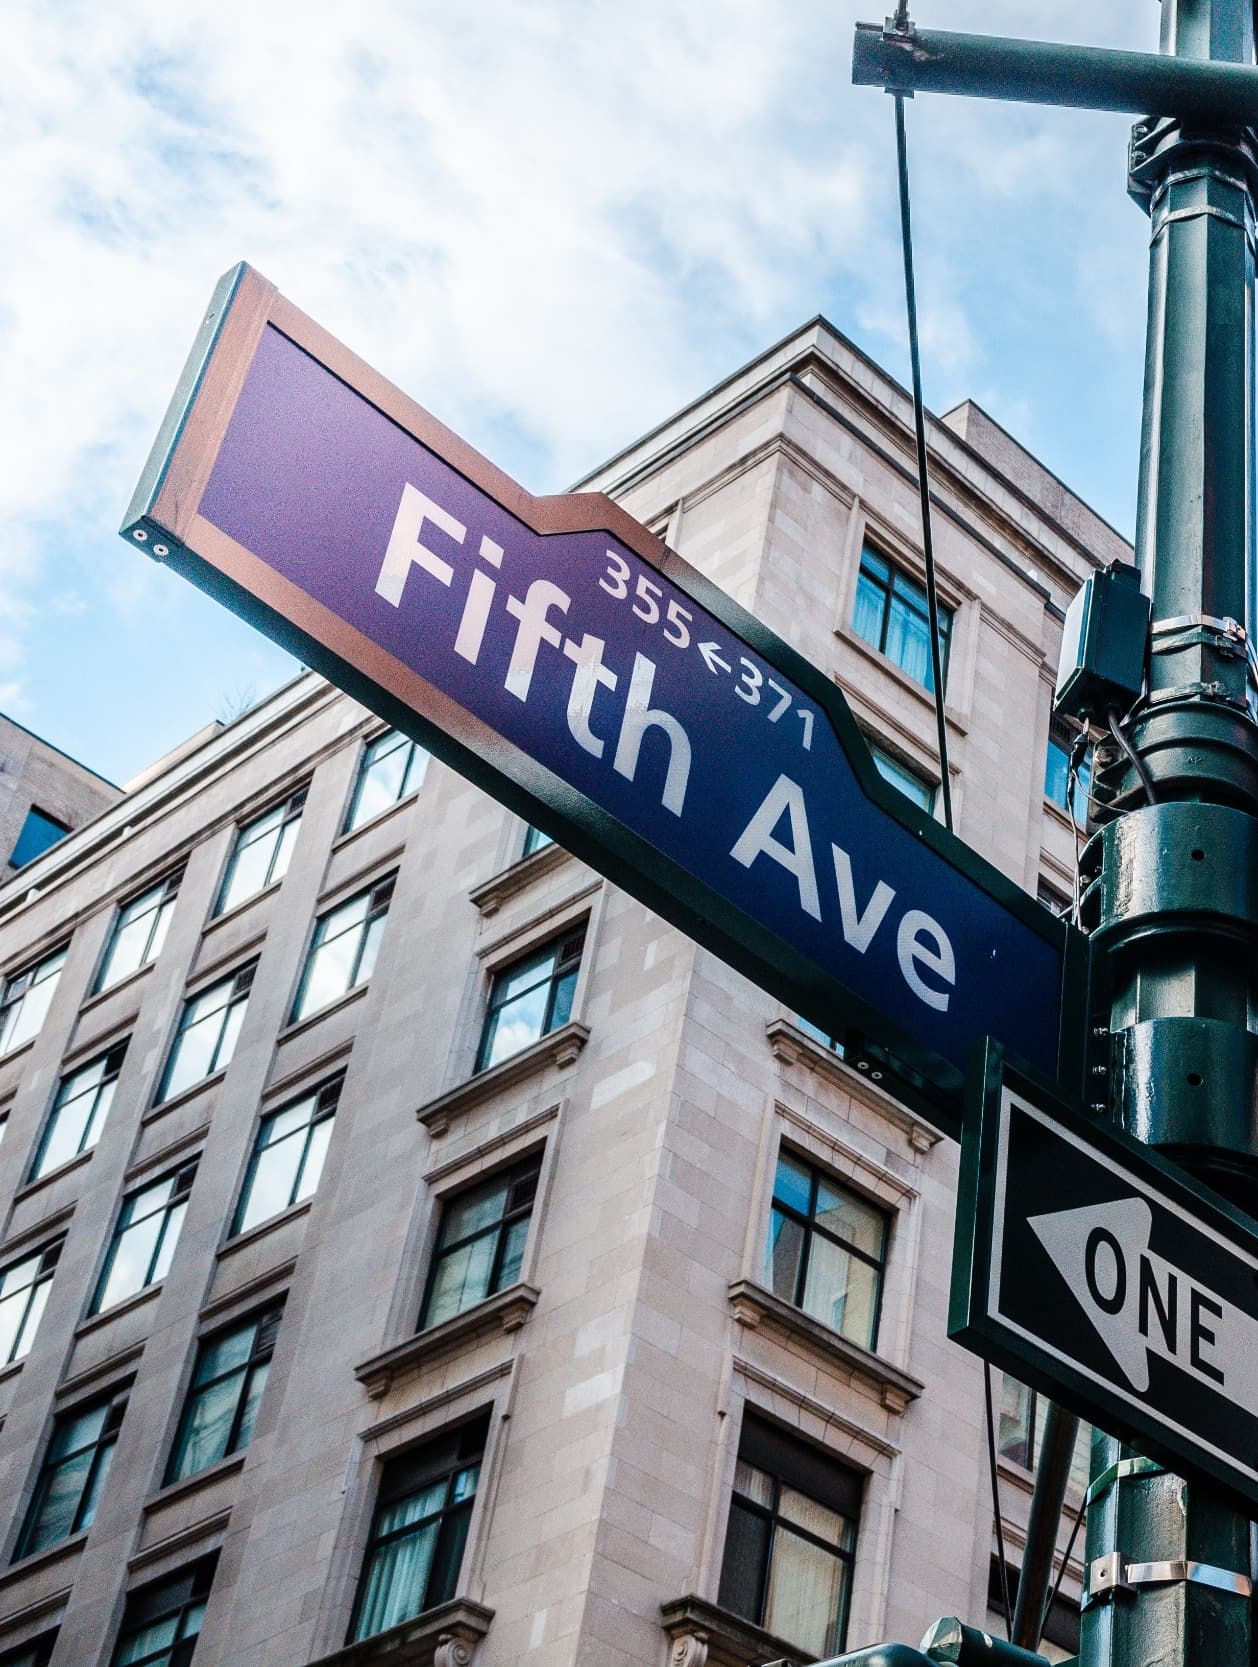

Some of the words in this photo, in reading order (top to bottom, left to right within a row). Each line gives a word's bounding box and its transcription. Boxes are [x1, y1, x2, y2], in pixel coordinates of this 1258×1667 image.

[373, 481, 694, 818] Fifth
[728, 772, 957, 1013] Ave
[598, 549, 694, 650] 355
[734, 657, 818, 752] 371
[1084, 1226, 1226, 1387] ONE
